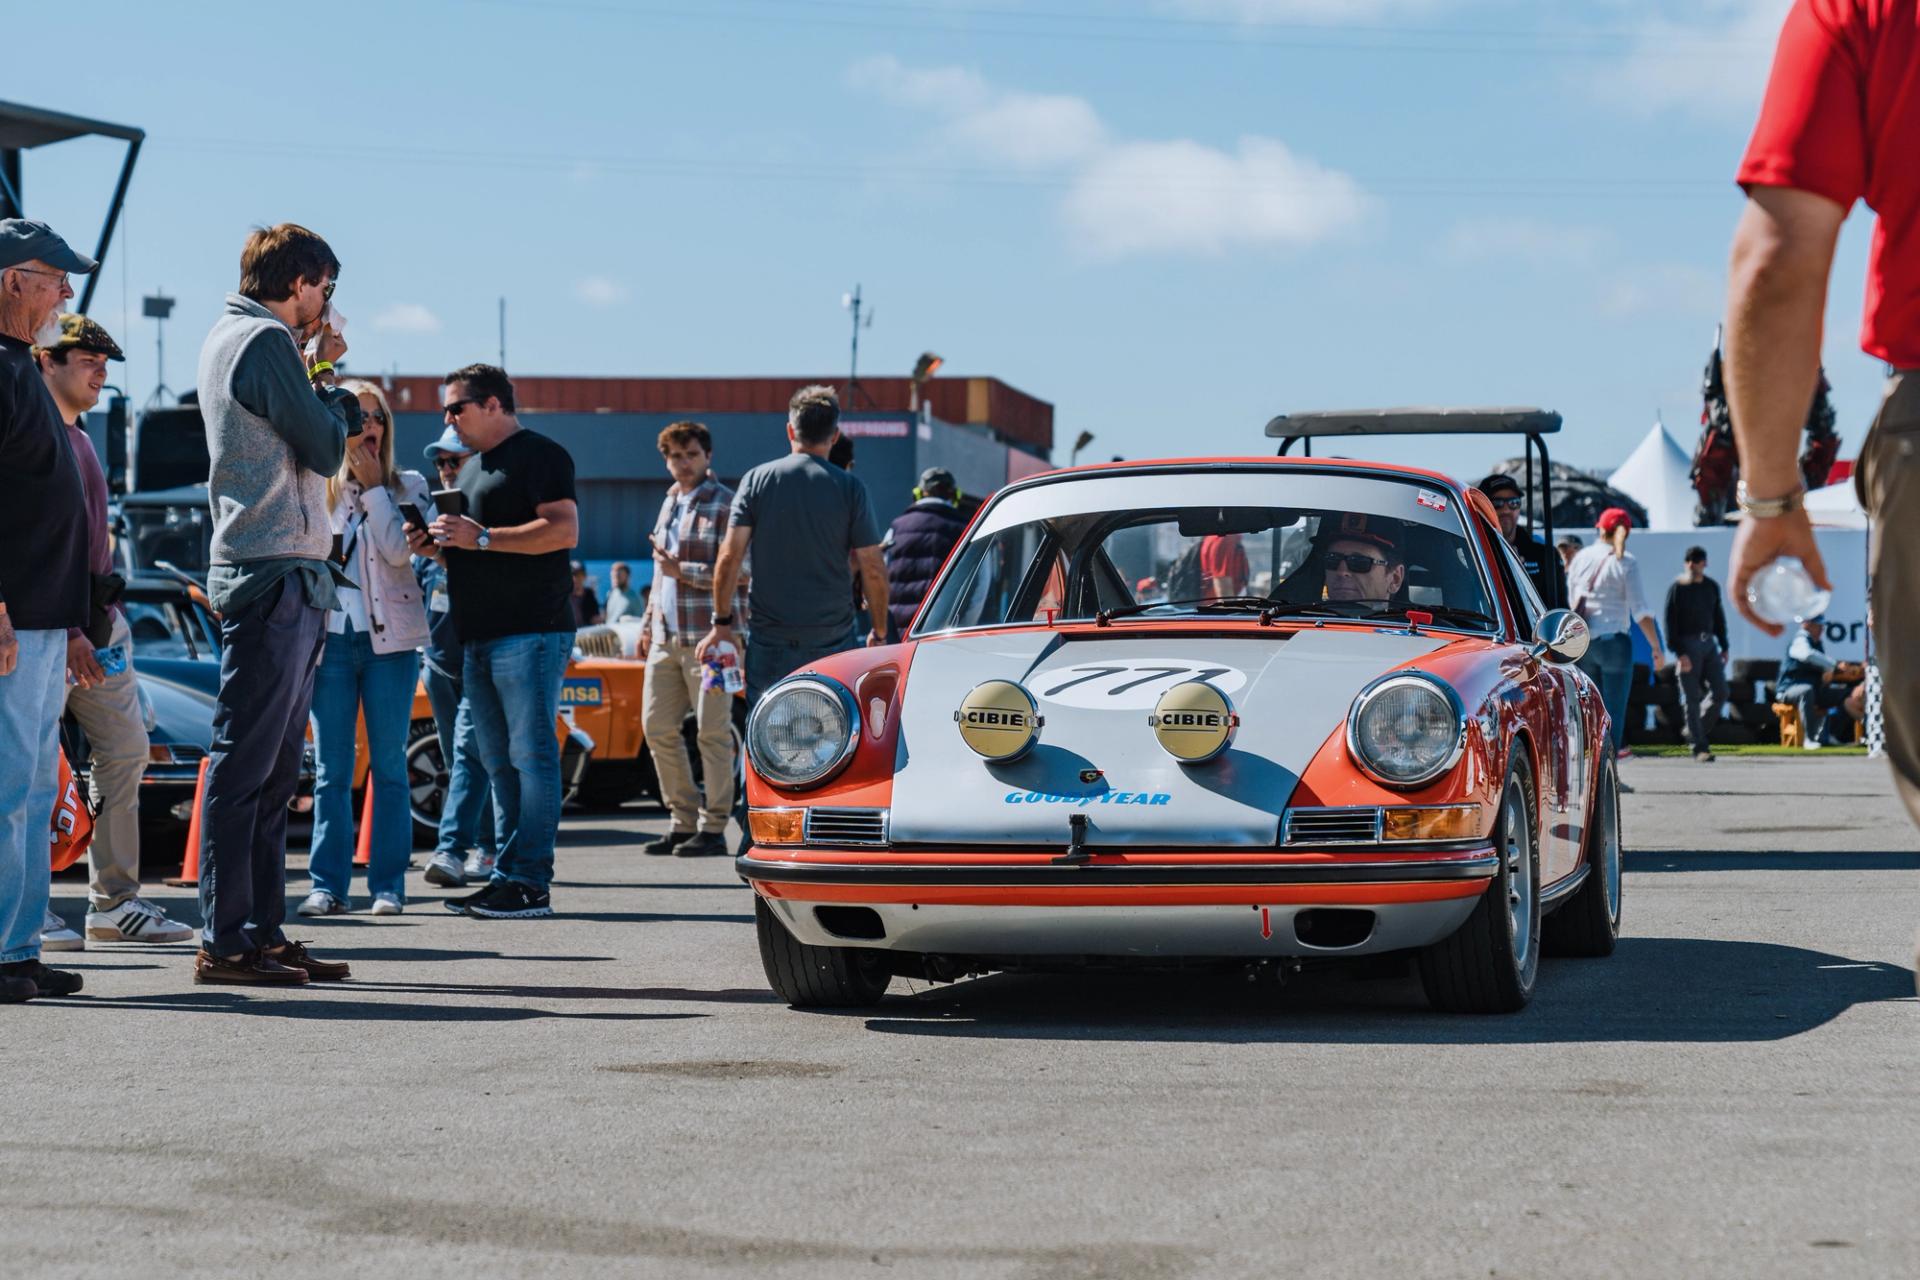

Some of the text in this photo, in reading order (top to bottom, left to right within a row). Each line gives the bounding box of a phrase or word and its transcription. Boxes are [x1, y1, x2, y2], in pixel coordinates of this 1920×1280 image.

[1825, 621, 1864, 643] or
[561, 686, 600, 702] nsa
[1004, 787, 1171, 807] GOODYEAR
